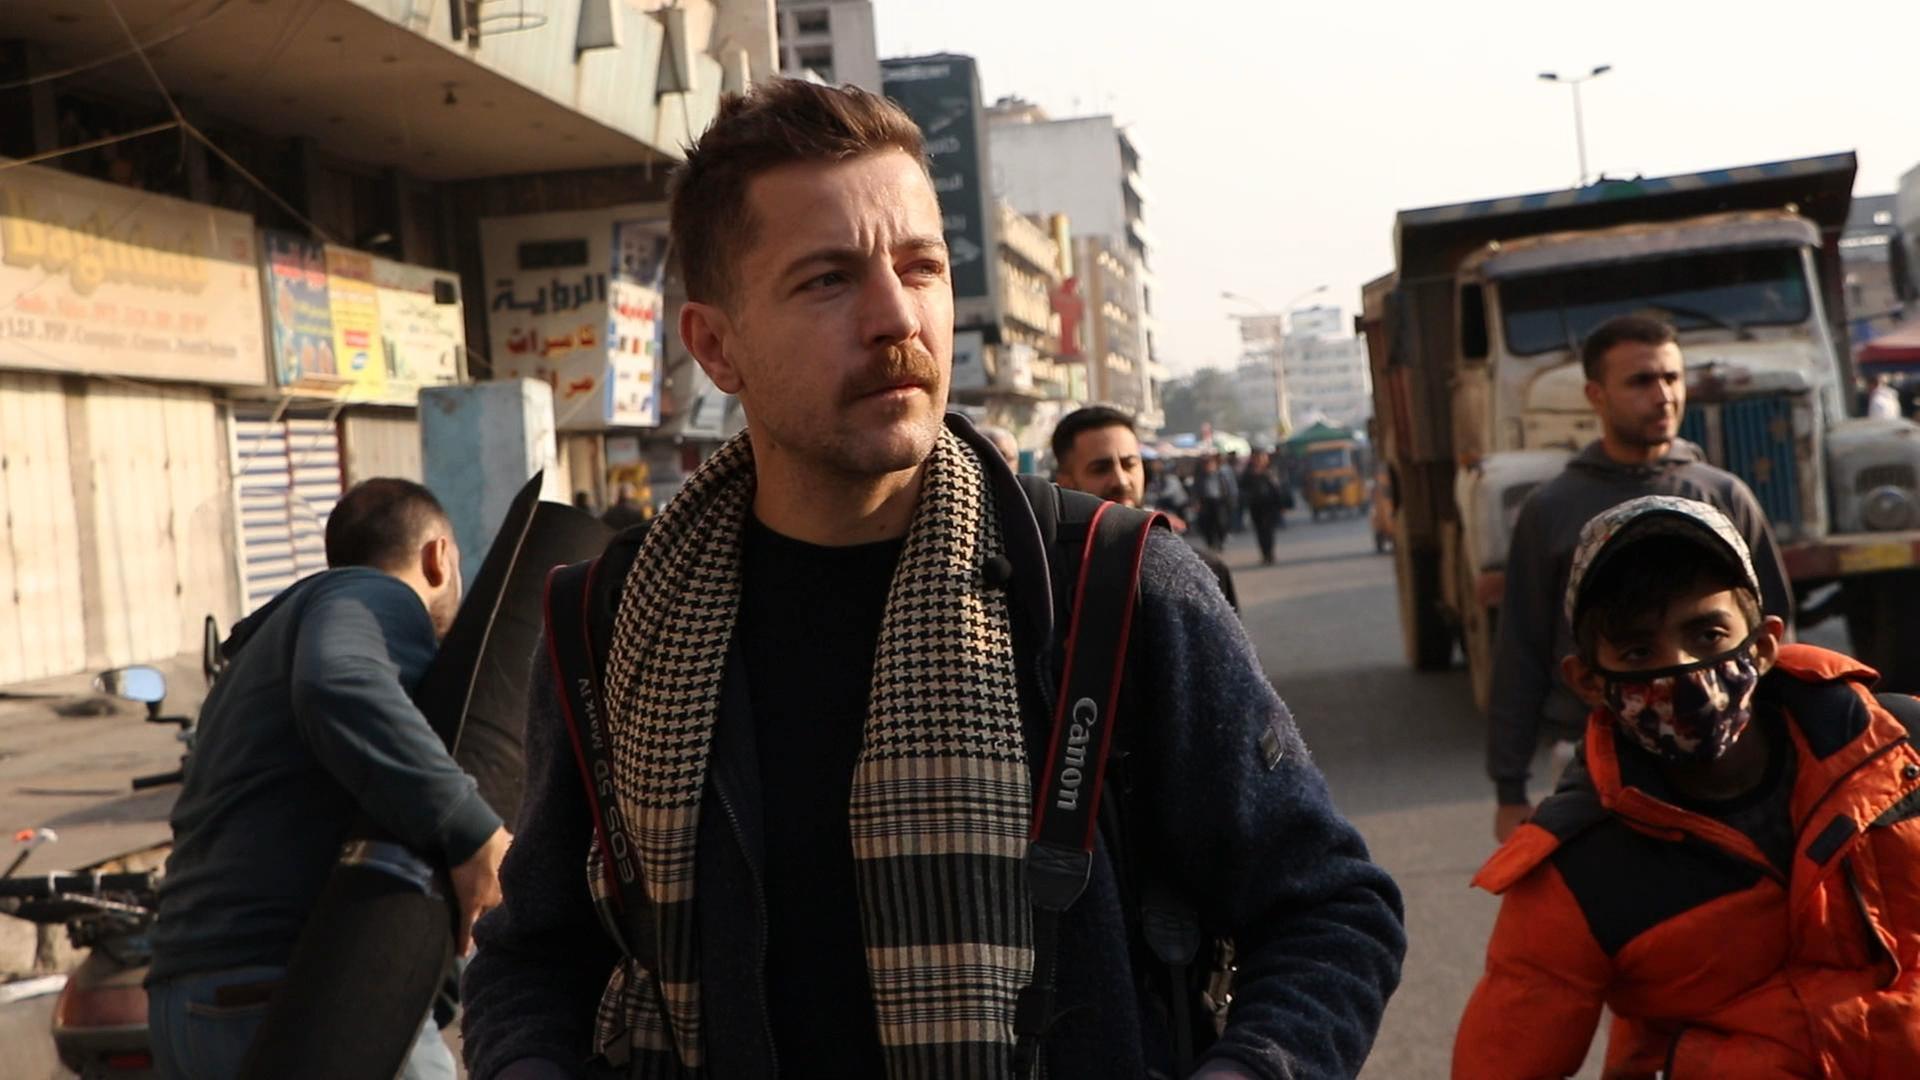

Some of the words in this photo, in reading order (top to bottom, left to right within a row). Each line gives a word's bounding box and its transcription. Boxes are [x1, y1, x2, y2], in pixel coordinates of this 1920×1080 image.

[584, 699, 604, 750] Mark
[1057, 697, 1098, 811] Canon
[593, 758, 613, 796] 5D
[606, 805, 635, 883] EOS
